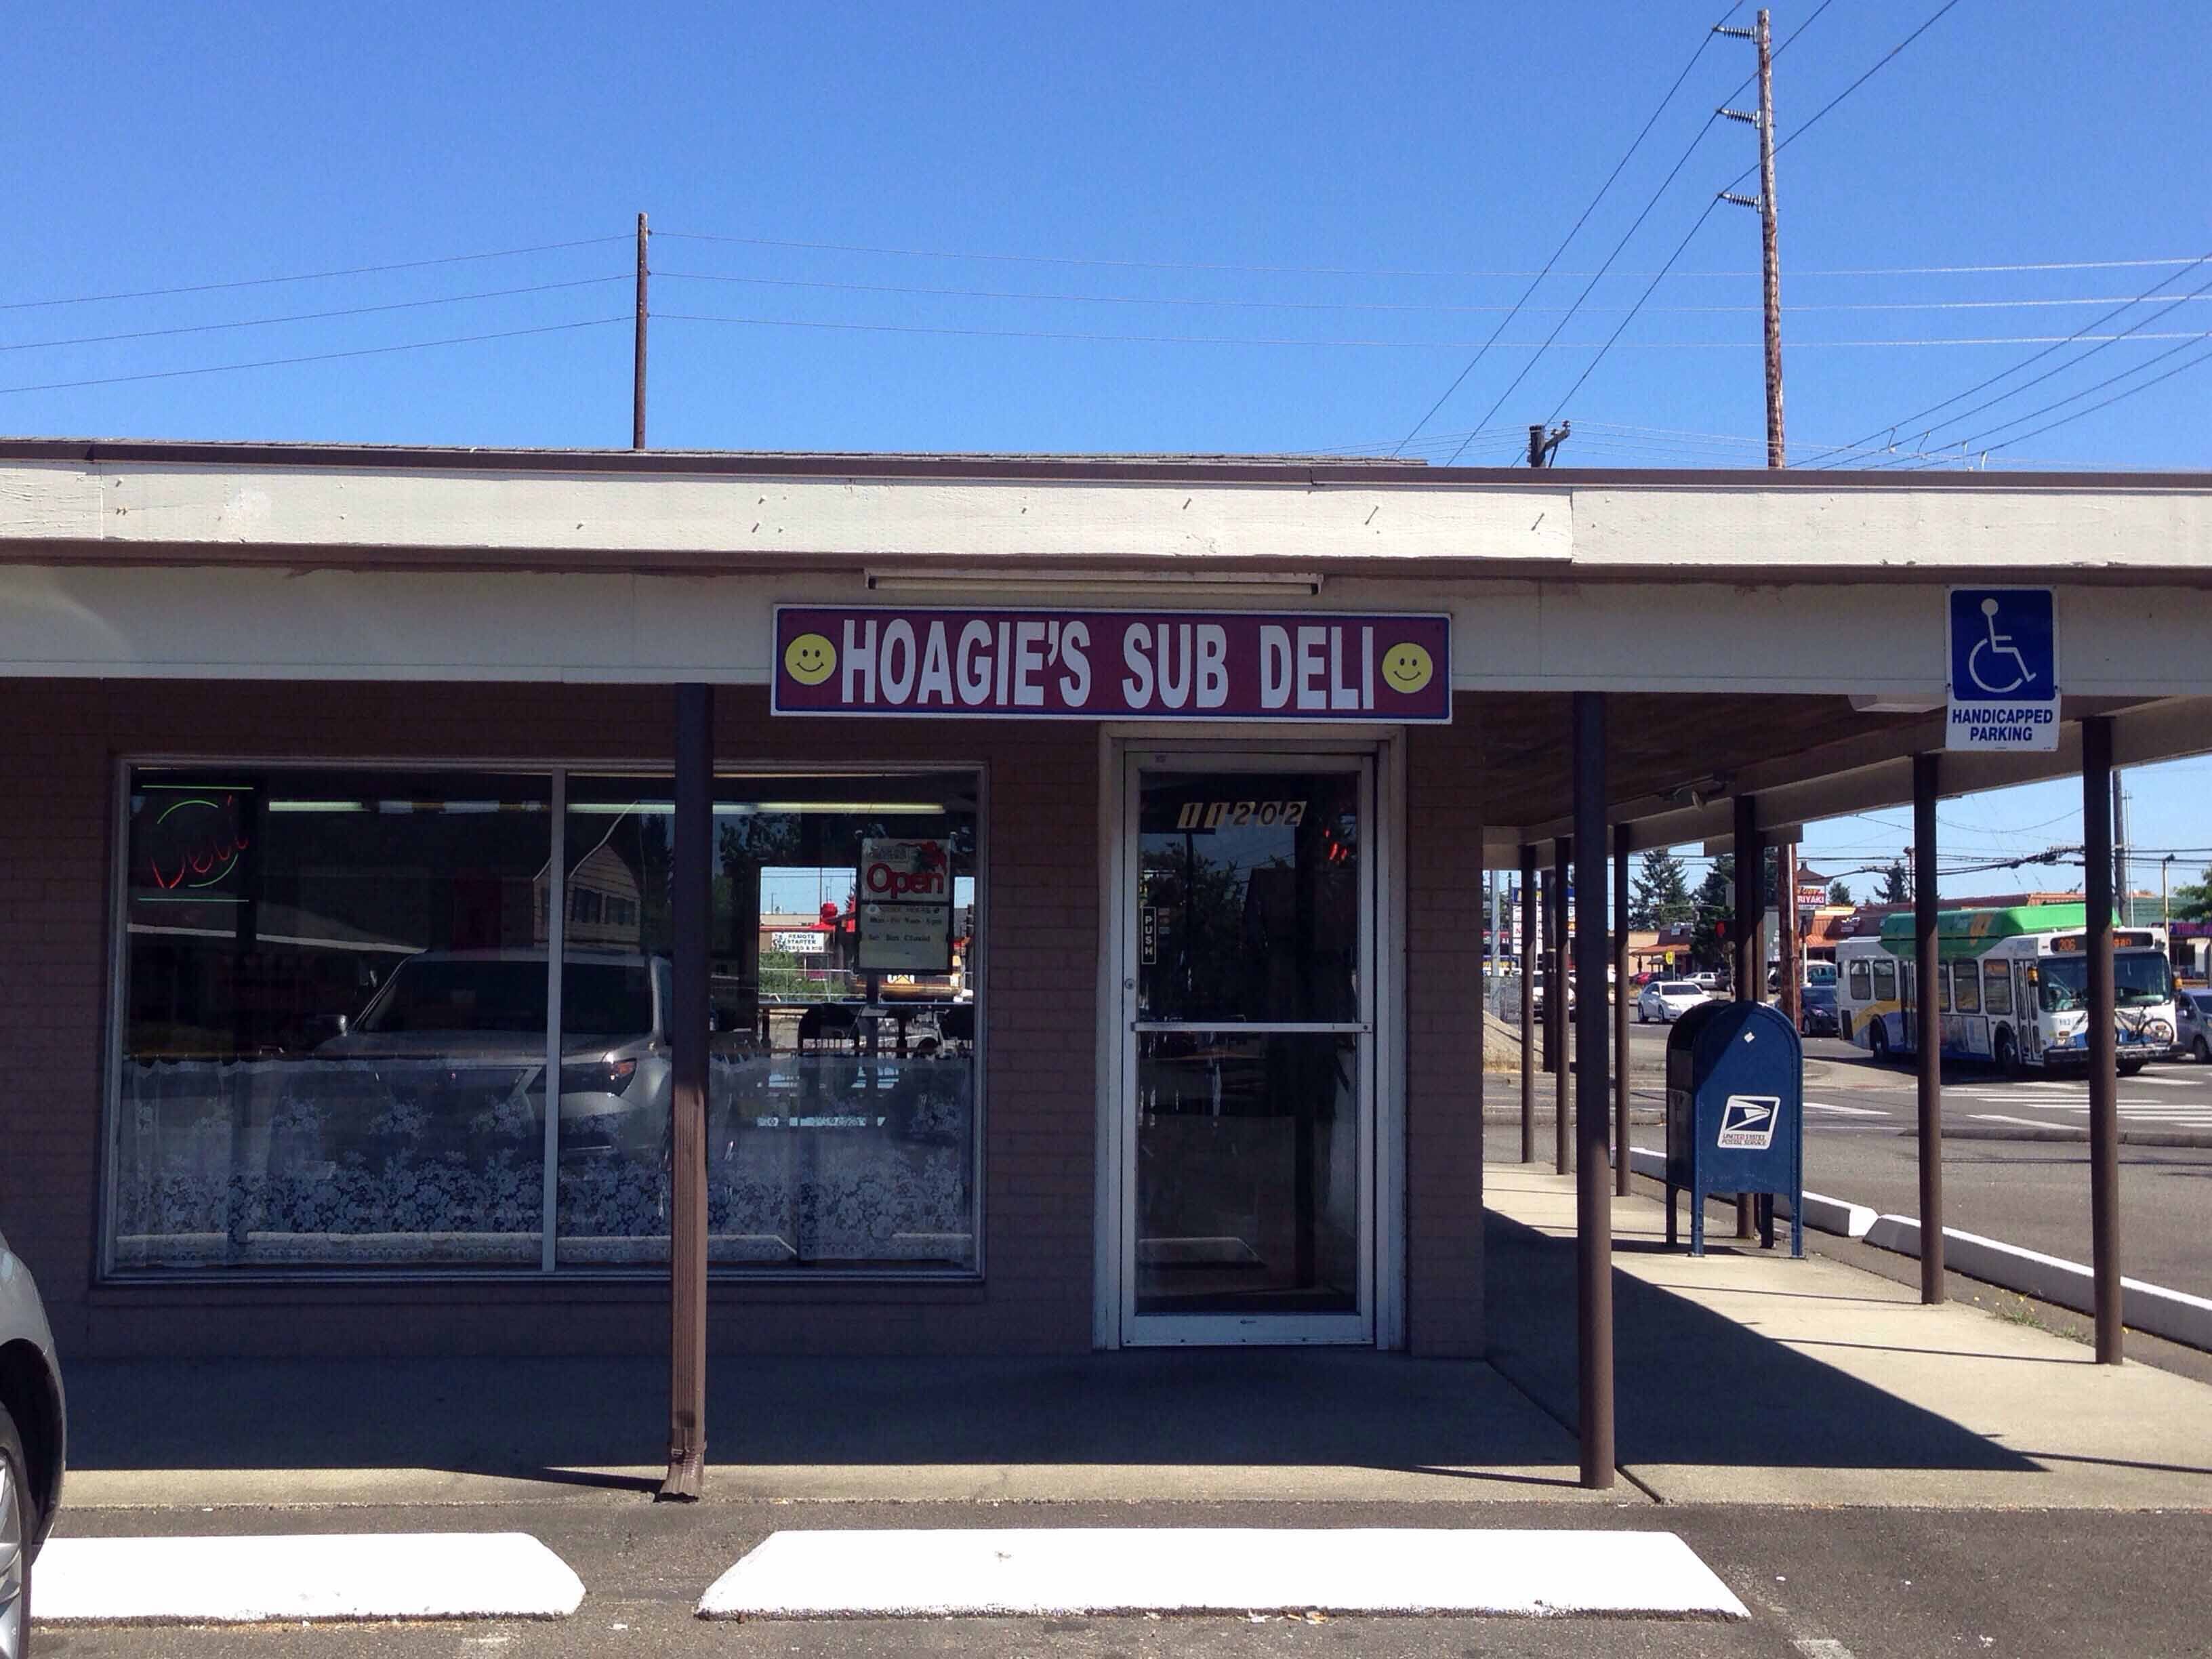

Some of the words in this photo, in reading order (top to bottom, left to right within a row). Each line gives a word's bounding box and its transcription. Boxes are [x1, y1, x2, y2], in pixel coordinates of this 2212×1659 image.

[841, 619, 1092, 708] HOAGIE'S
[1122, 623, 1229, 710] SUB
[1260, 626, 1375, 710] DELI
[1952, 709, 2053, 724] HANDICAPPED
[1970, 726, 2032, 741] PARKING
[1181, 802, 1304, 828] 11202
[867, 863, 944, 899] Open
[1797, 895, 1824, 903] RIYAKI
[1145, 916, 1153, 955] PUSH
